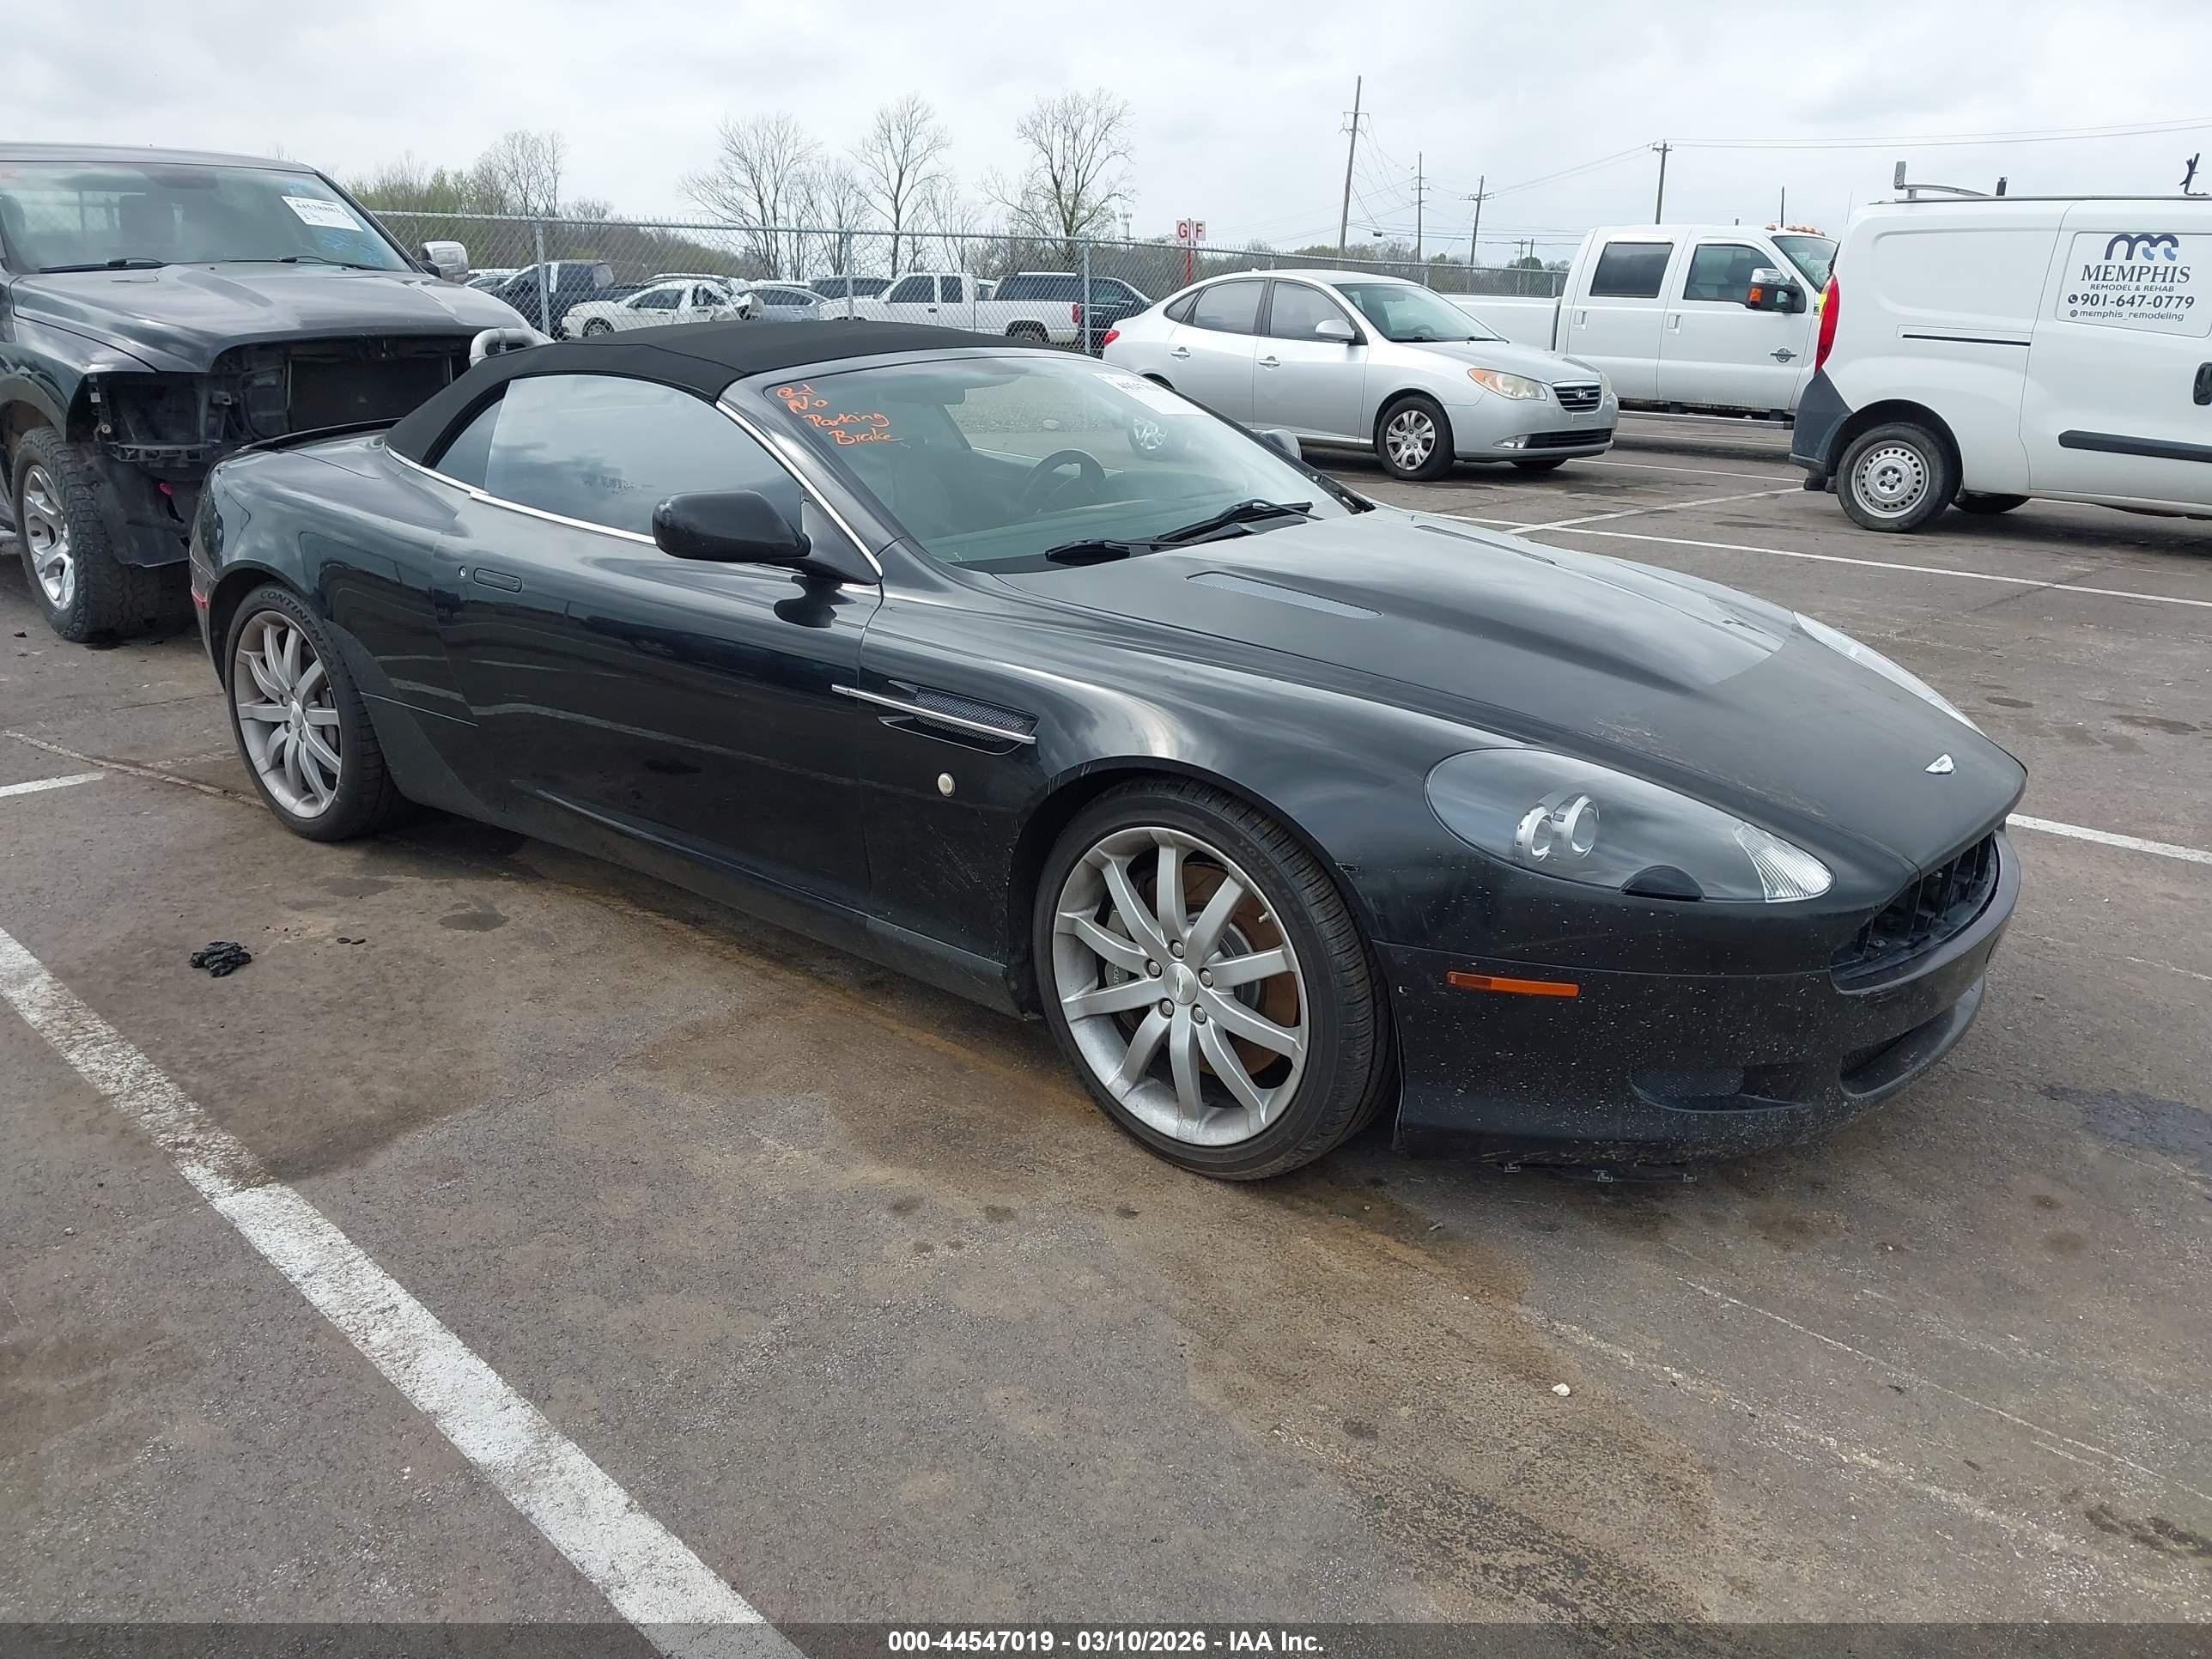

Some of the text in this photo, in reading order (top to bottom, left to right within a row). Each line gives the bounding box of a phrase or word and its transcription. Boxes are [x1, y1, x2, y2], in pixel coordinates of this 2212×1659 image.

[2081, 264, 2191, 283] MEMPHIS
[2090, 283, 2132, 292] REMODEL
[2143, 284, 2175, 293] REHAB
[2080, 293, 2195, 310] 901-647-0779
